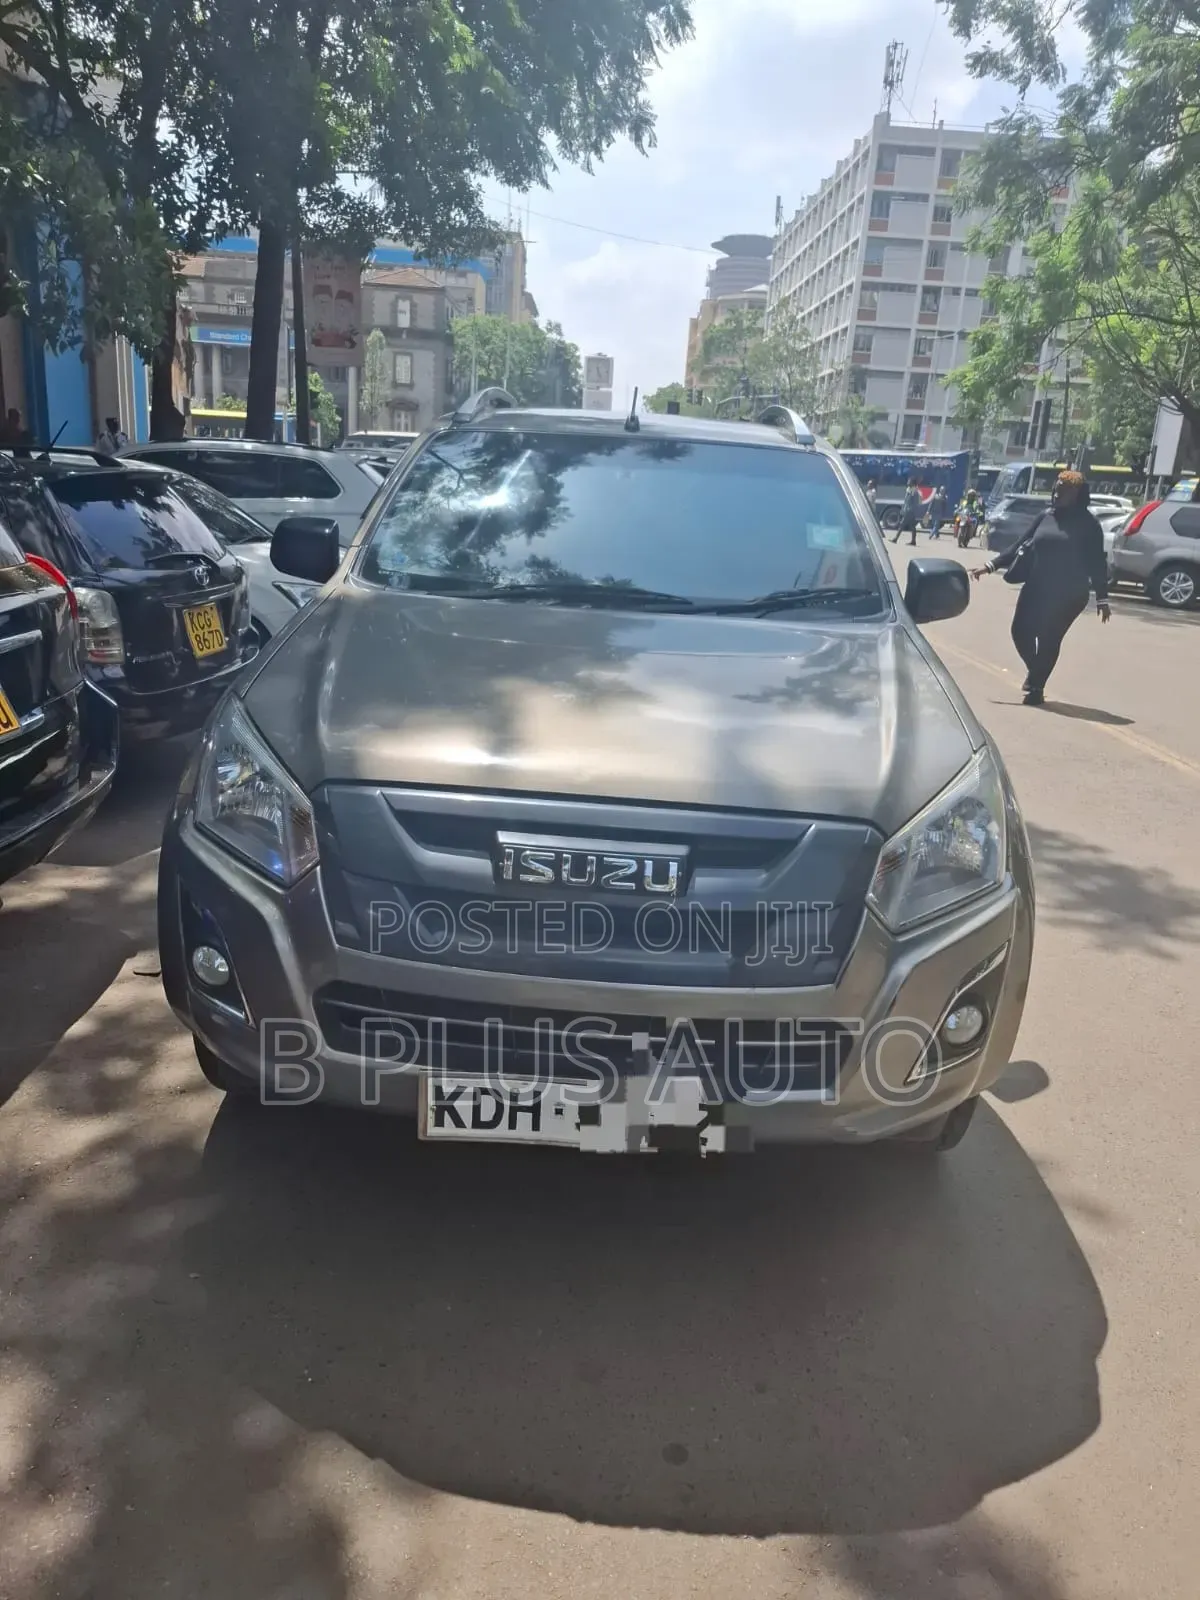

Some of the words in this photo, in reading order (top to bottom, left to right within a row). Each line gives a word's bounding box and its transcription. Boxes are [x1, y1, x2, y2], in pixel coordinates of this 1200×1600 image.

[188, 610, 212, 633] KCG
[194, 629, 224, 652] 867D
[502, 848, 679, 893] ISUZU
[432, 1084, 542, 1133] KDH
